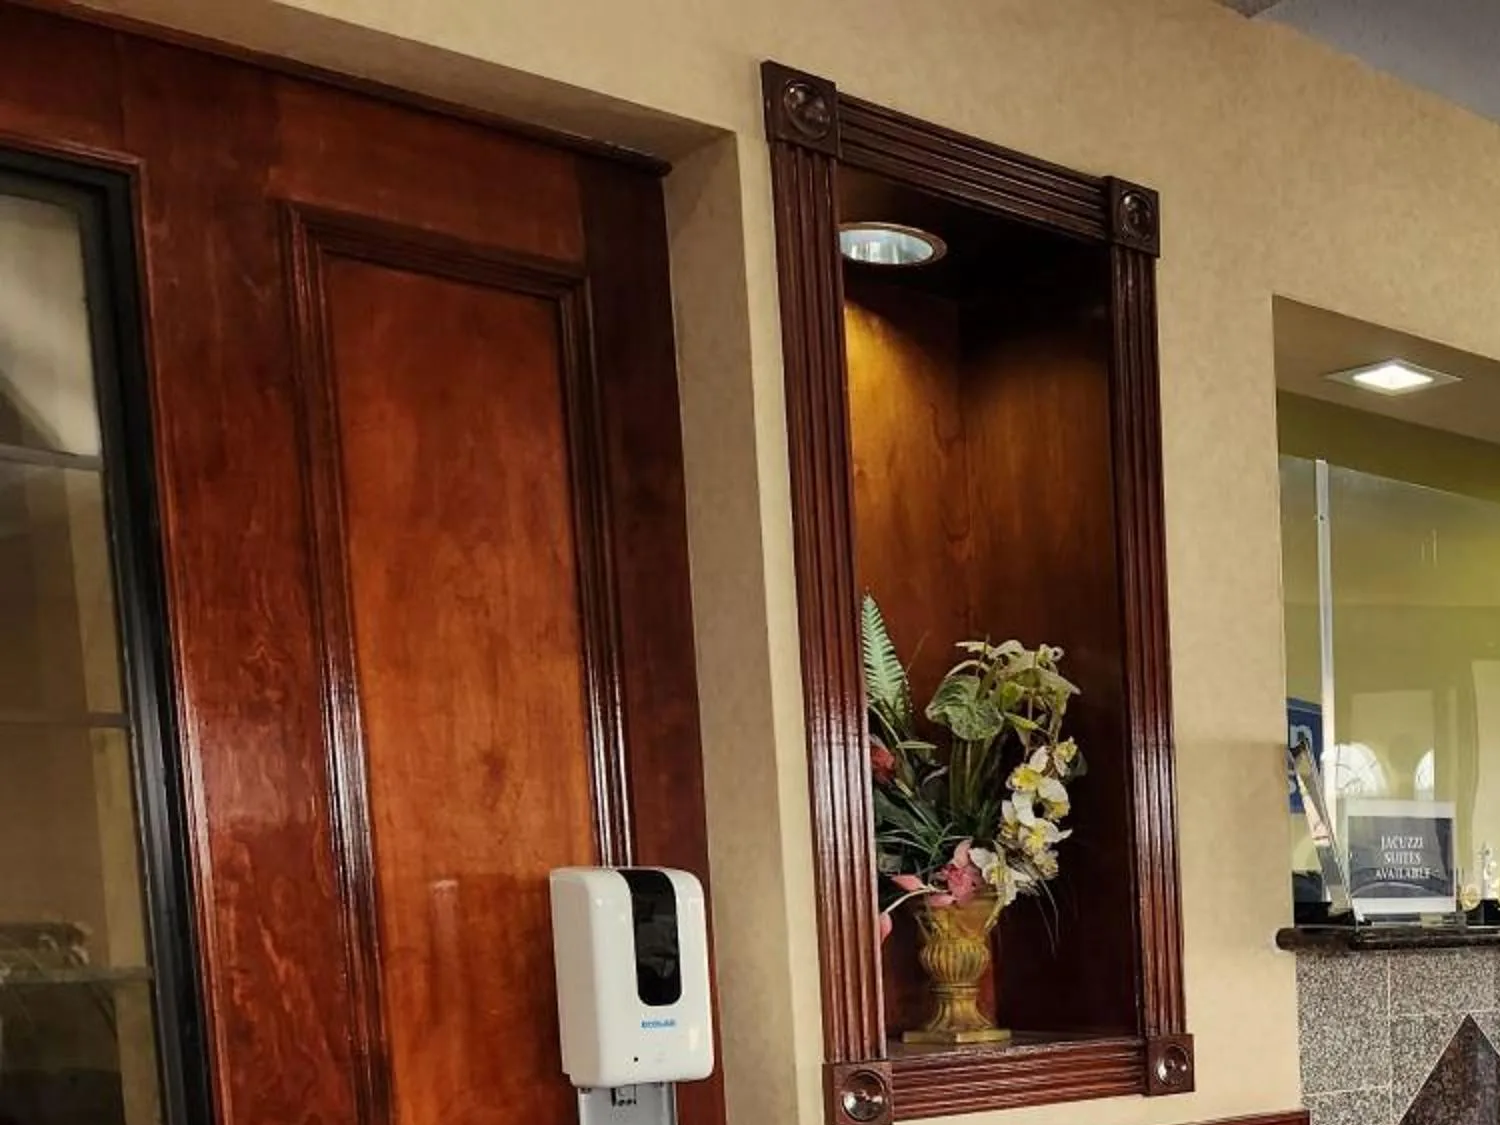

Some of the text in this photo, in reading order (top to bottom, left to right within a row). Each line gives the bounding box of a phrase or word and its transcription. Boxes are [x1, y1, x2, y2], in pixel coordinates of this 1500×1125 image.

[1380, 834, 1424, 851] JACUZZI
[1383, 850, 1422, 865] SUITES
[1375, 867, 1432, 880] AVAILABLE
